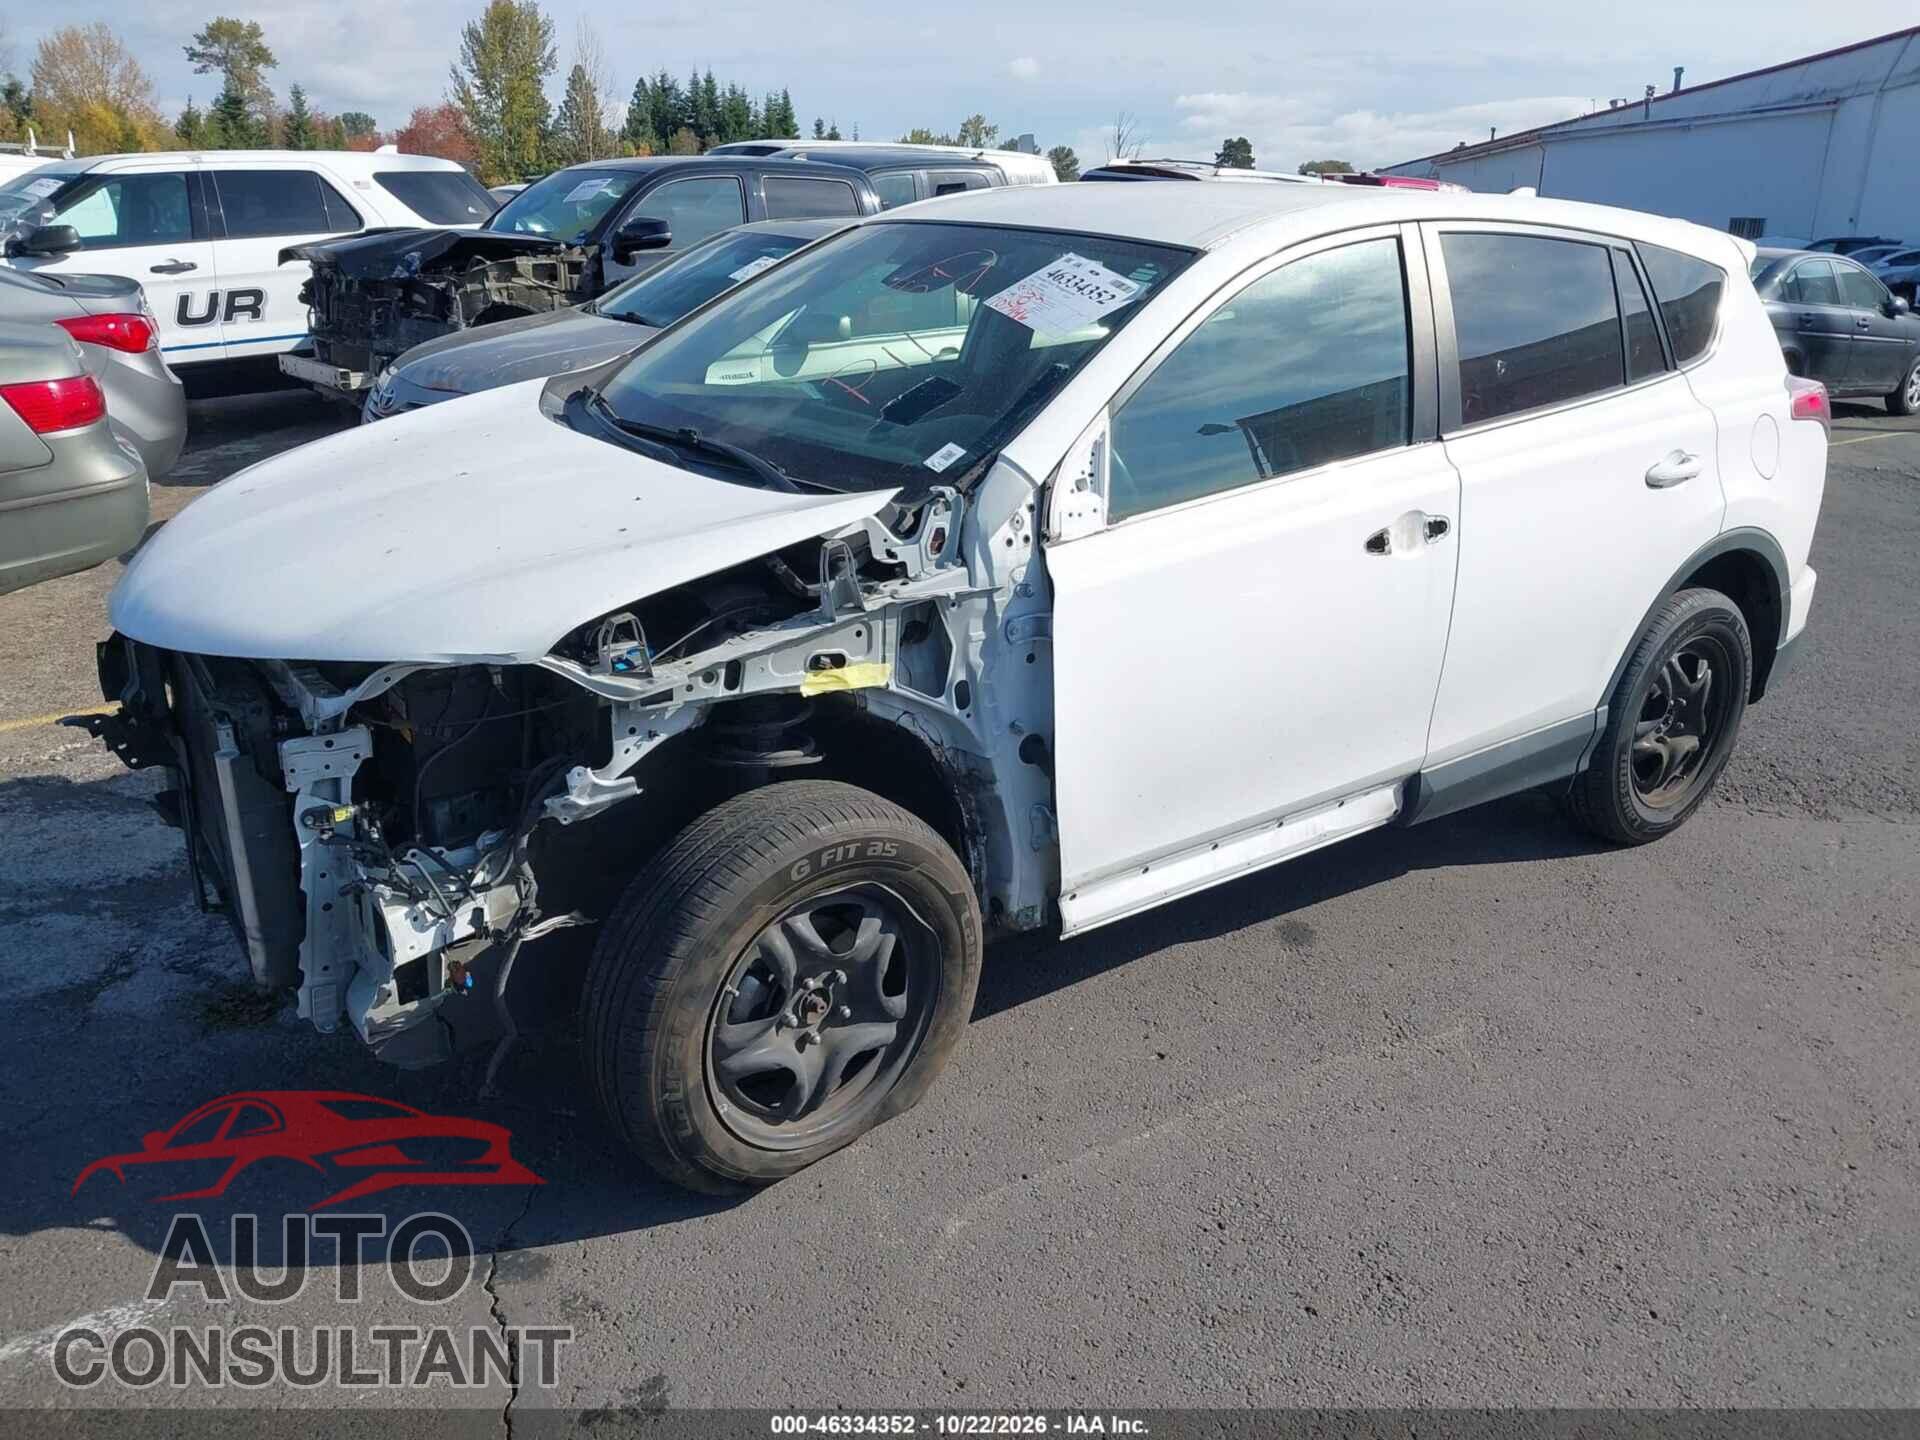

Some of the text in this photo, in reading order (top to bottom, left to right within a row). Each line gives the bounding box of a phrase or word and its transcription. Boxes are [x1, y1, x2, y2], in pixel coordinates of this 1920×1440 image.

[1047, 269, 1117, 305] 46334352
[175, 287, 265, 327] UR
[790, 858, 811, 881] G
[820, 843, 862, 868] FIT
